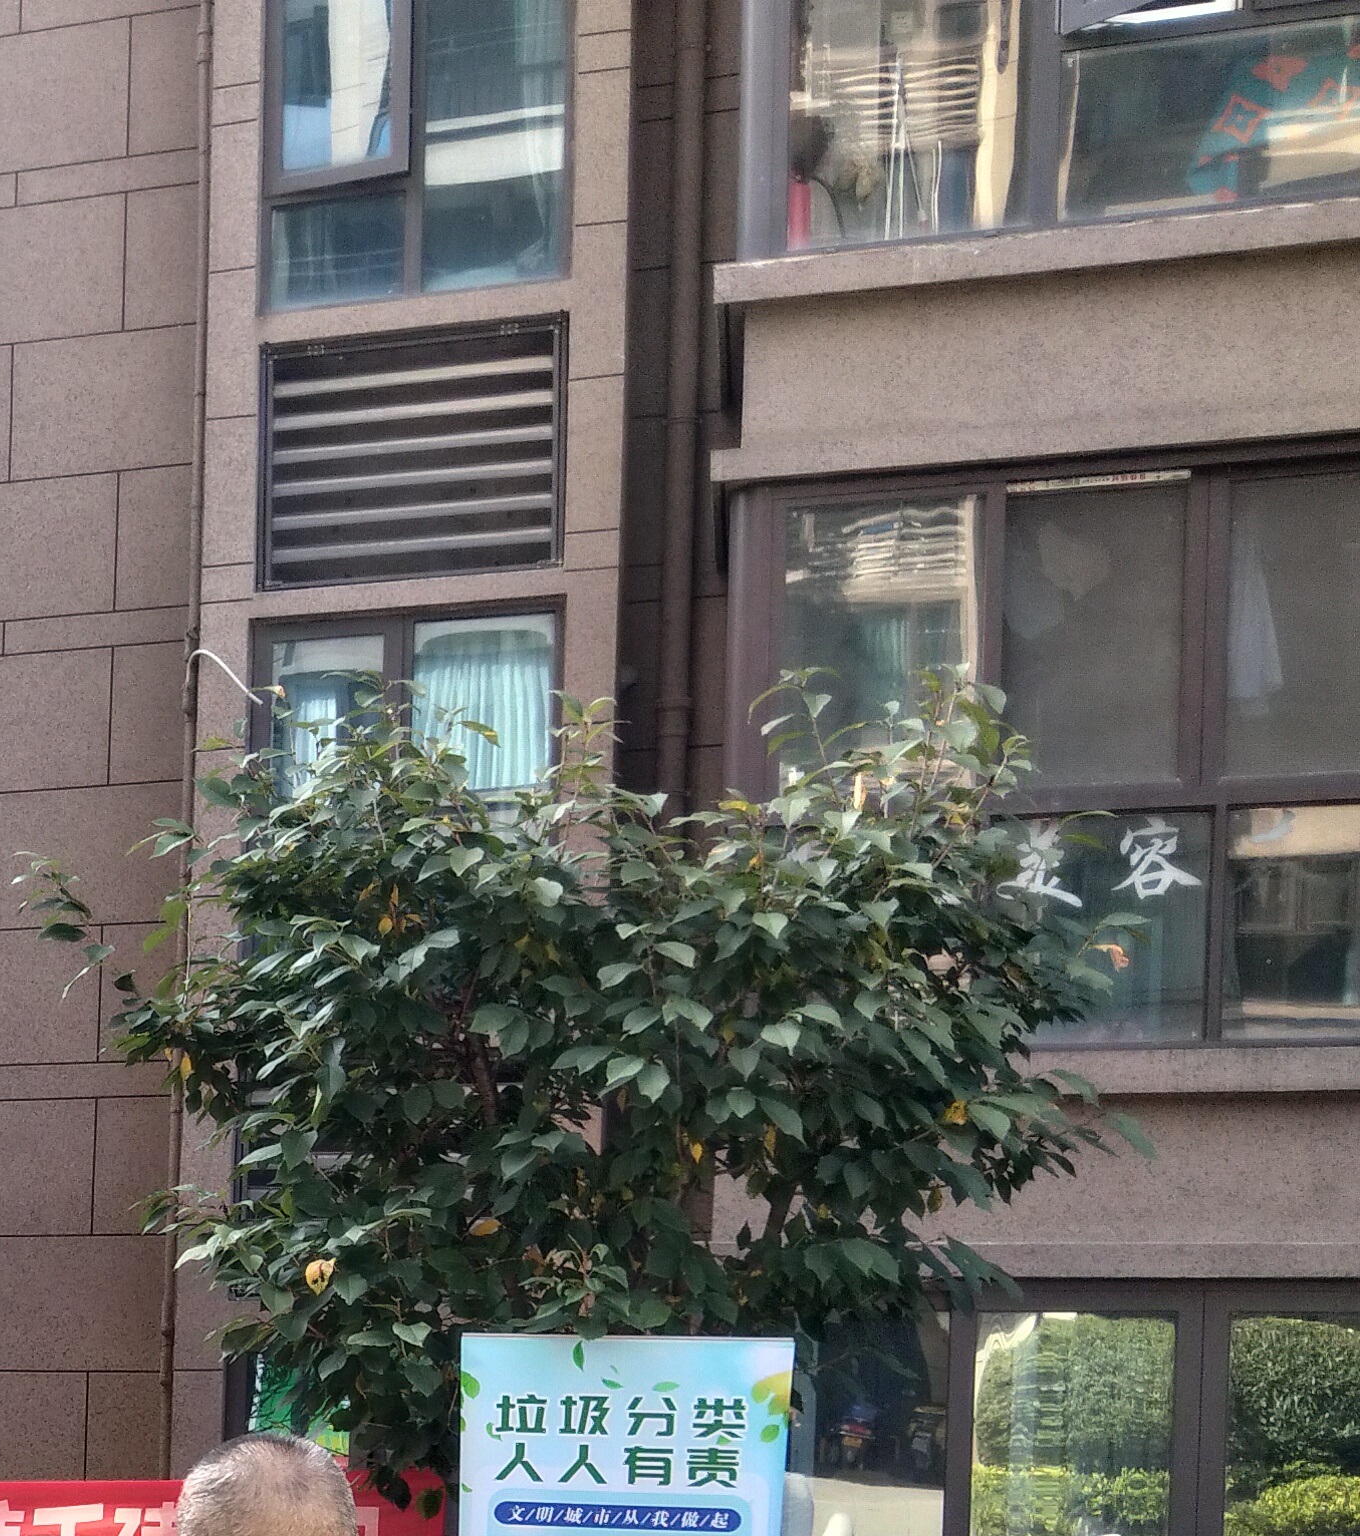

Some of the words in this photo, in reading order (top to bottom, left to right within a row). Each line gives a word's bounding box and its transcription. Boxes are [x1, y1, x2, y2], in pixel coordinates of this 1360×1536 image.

[495, 1394, 748, 1439] 垃圾分类
[494, 1443, 741, 1488] 人人有责
